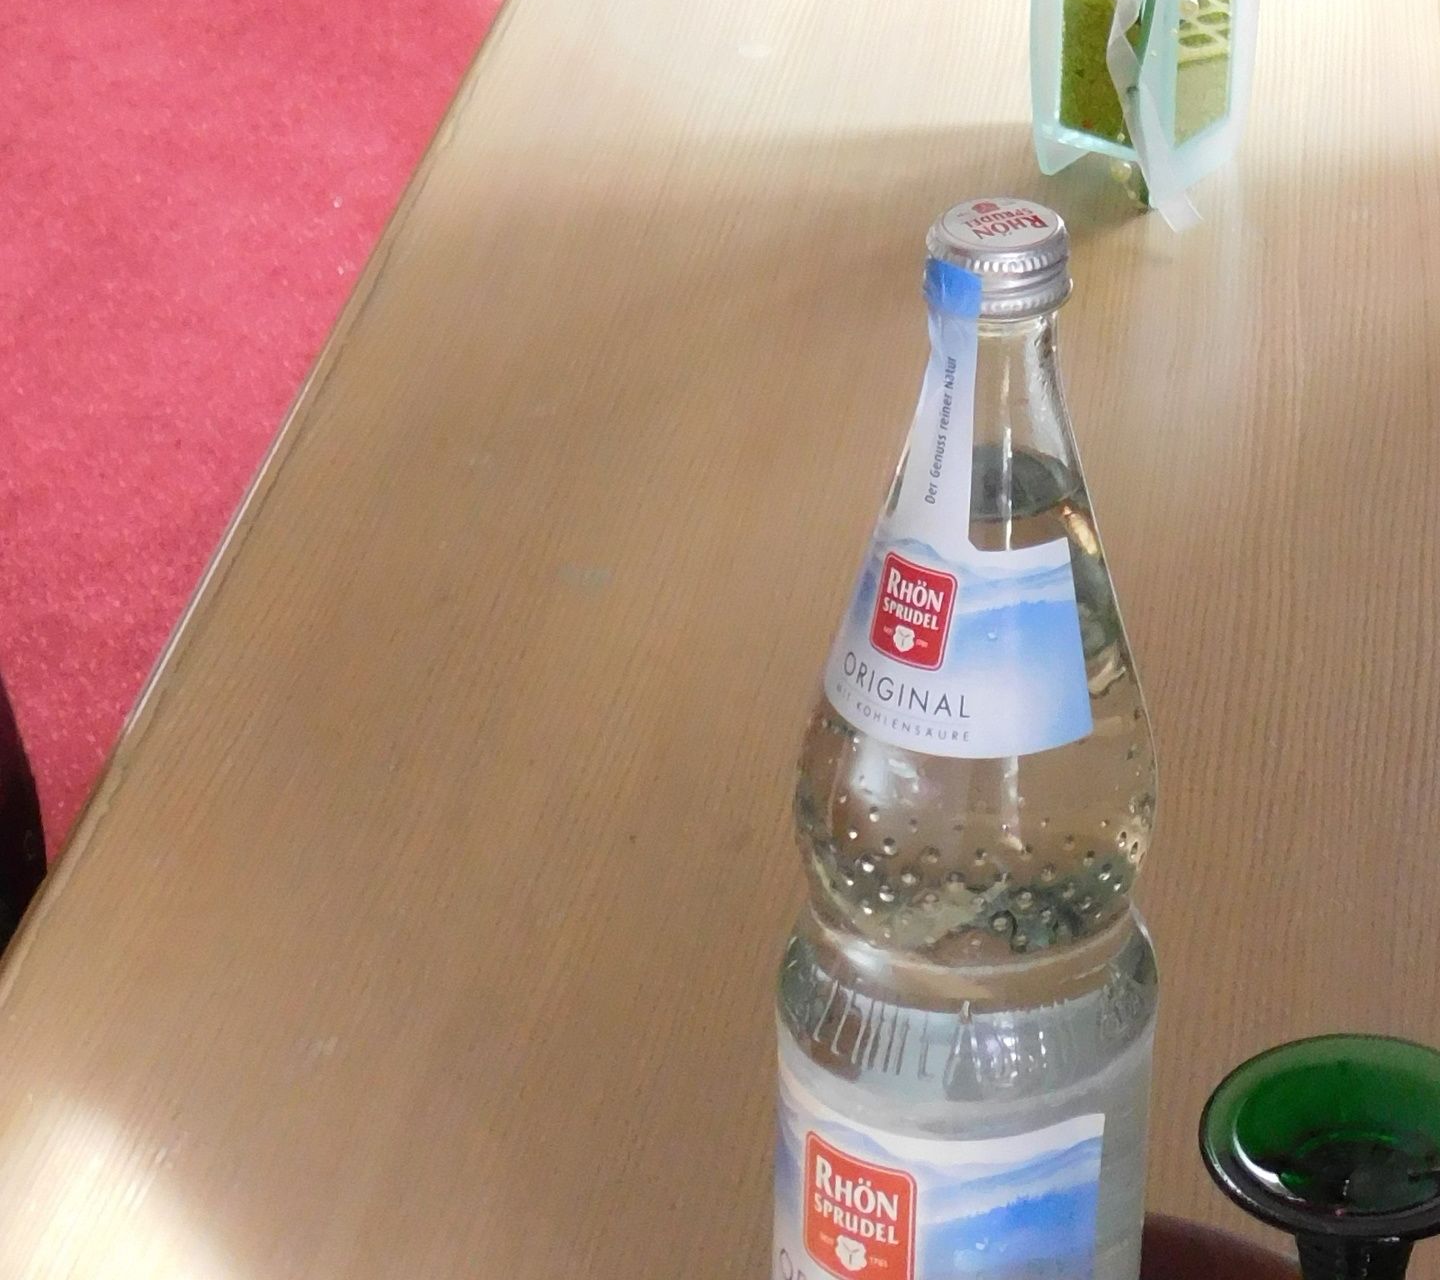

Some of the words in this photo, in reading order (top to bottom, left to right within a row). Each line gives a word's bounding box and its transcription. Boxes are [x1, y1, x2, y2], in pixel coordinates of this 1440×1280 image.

[964, 207, 1034, 228] SPRUDEL
[944, 356, 957, 390] Natur
[940, 394, 953, 431] reiner
[930, 434, 947, 478] Genuss
[924, 482, 937, 505] Der
[885, 566, 945, 613] RHÖN
[882, 597, 940, 631] SPRUDEL
[843, 651, 971, 719] ORIGINAL
[815, 1154, 899, 1222] RHÖN
[814, 1192, 900, 1245] SPRUDEL
